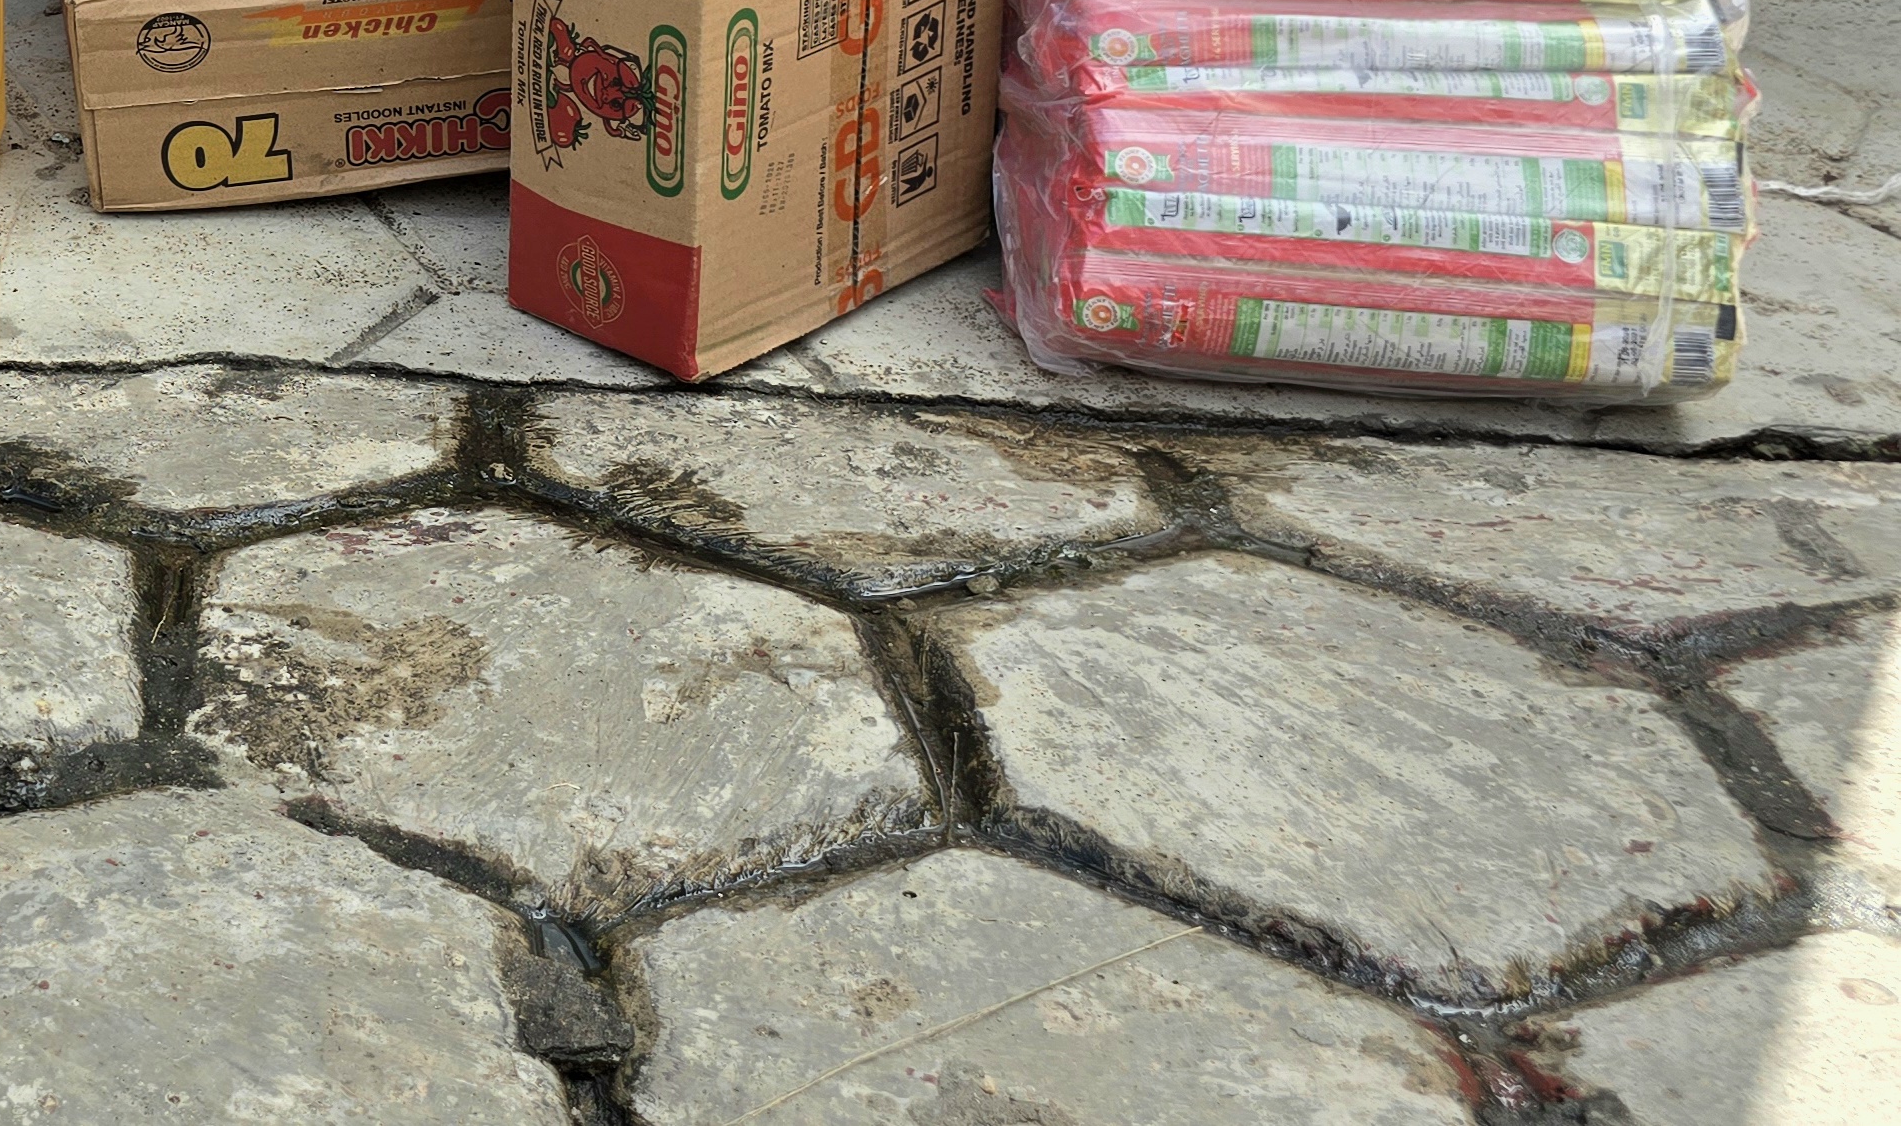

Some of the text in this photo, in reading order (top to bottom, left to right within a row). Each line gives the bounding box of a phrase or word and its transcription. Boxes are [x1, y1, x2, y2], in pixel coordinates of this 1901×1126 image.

[301, 13, 438, 42] Chicken
[516, 19, 527, 107] Tomato Mix
[532, 36, 543, 58] RED
[532, 59, 542, 70] &
[961, 23, 975, 117] HANDLING
[532, 70, 543, 95] RICH
[756, 39, 774, 152] TOMATO MIX
[334, 100, 467, 124] INSTANT NOODLES
[533, 98, 543, 111] IN
[655, 63, 681, 157] Gino
[725, 54, 749, 157] Gino
[534, 112, 547, 144] FIBRE
[160, 112, 293, 192] 70
[819, 142, 827, 170] Batch
[818, 176, 826, 208] Before
[816, 208, 825, 230] Best
[814, 236, 823, 286] Production
[1599, 240, 1613, 275] FMN
[581, 245, 600, 320] GOOD SOURCE
